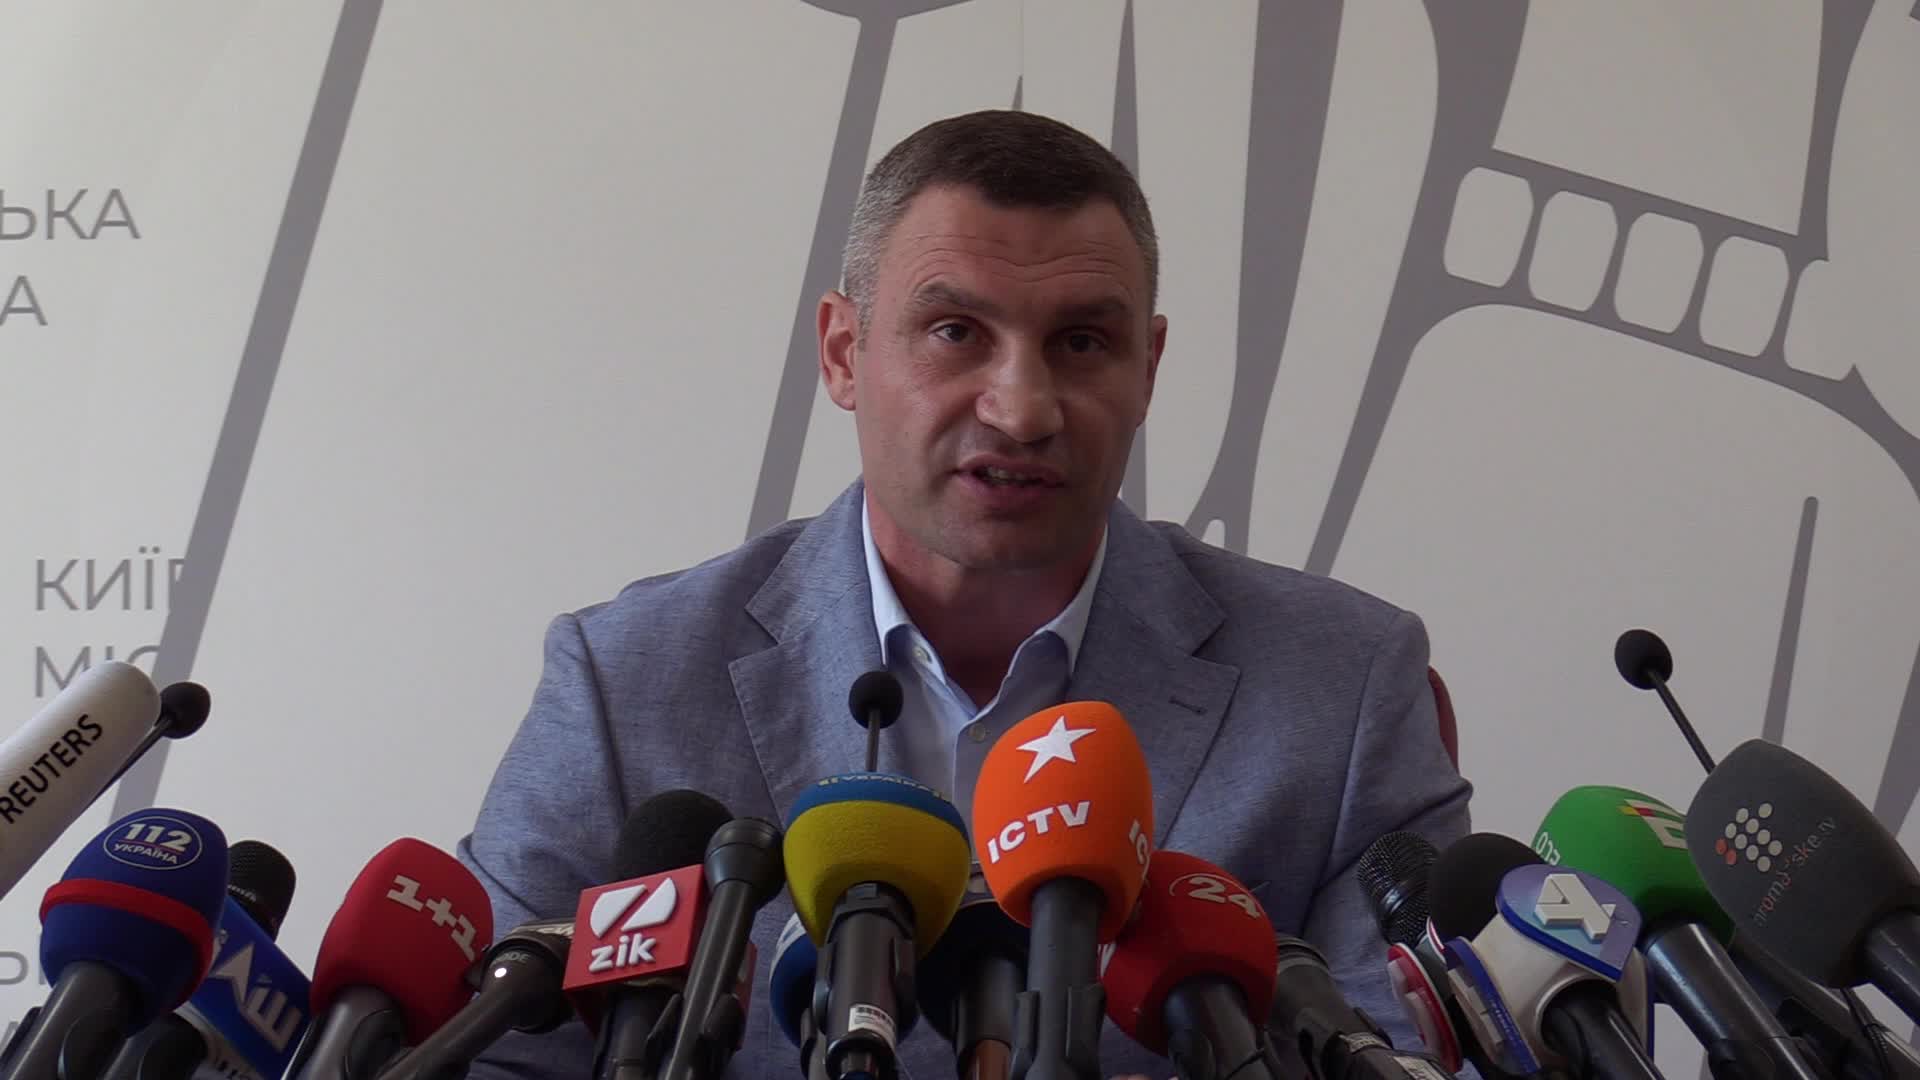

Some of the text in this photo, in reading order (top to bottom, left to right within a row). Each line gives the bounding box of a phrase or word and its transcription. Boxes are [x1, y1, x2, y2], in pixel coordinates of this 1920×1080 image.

[0, 714, 103, 824] REUTERS
[123, 822, 194, 852] 112
[987, 801, 1090, 863] ICTV
[113, 843, 179, 865] УКРАЇНА
[386, 874, 477, 962] 1+1
[1189, 876, 1260, 919] 24
[588, 933, 657, 973] zik
